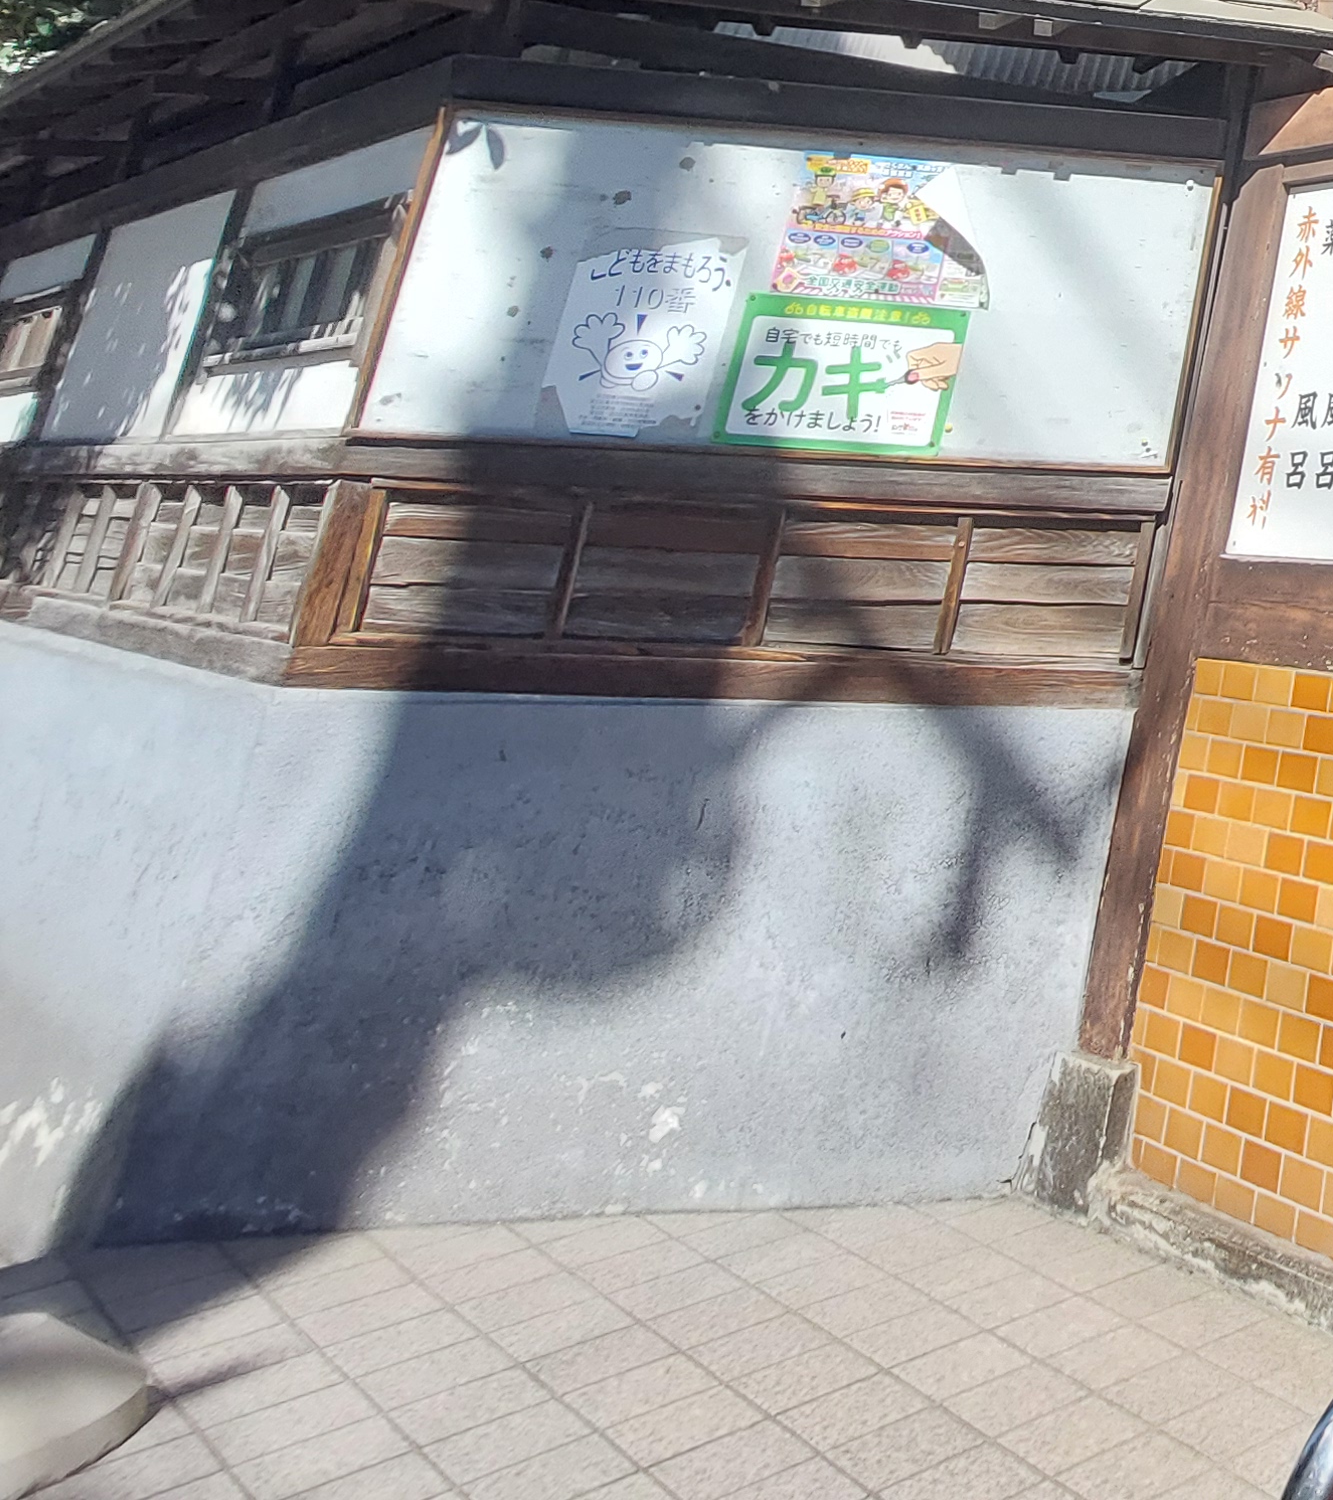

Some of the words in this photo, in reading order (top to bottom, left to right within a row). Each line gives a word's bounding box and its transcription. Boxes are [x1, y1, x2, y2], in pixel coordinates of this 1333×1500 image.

[615, 285, 696, 313] 110番
[766, 327, 902, 350] 自宅でも短時間でも
[742, 343, 901, 419] カギ
[745, 406, 881, 433] をかけましょう!
